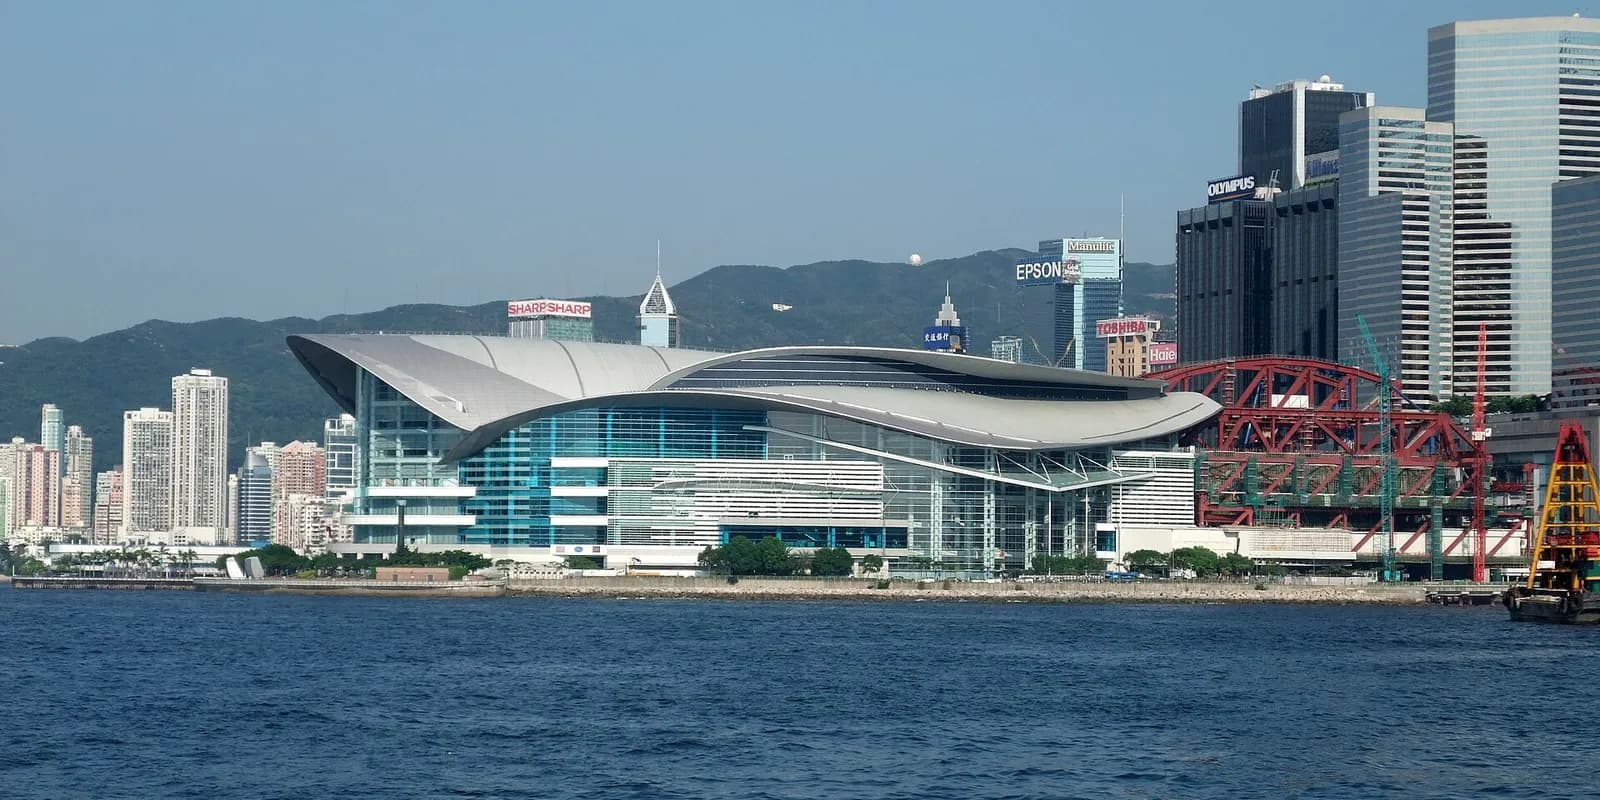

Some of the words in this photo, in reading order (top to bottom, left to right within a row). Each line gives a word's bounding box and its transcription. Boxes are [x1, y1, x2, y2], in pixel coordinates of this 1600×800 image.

[1208, 176, 1255, 197] OLYMPUS
[1068, 241, 1115, 251] Manulife
[1016, 261, 1061, 280] EPSON
[509, 303, 546, 315] SHARP
[547, 302, 591, 315] SHARP
[1097, 321, 1146, 335] TOSHIBA
